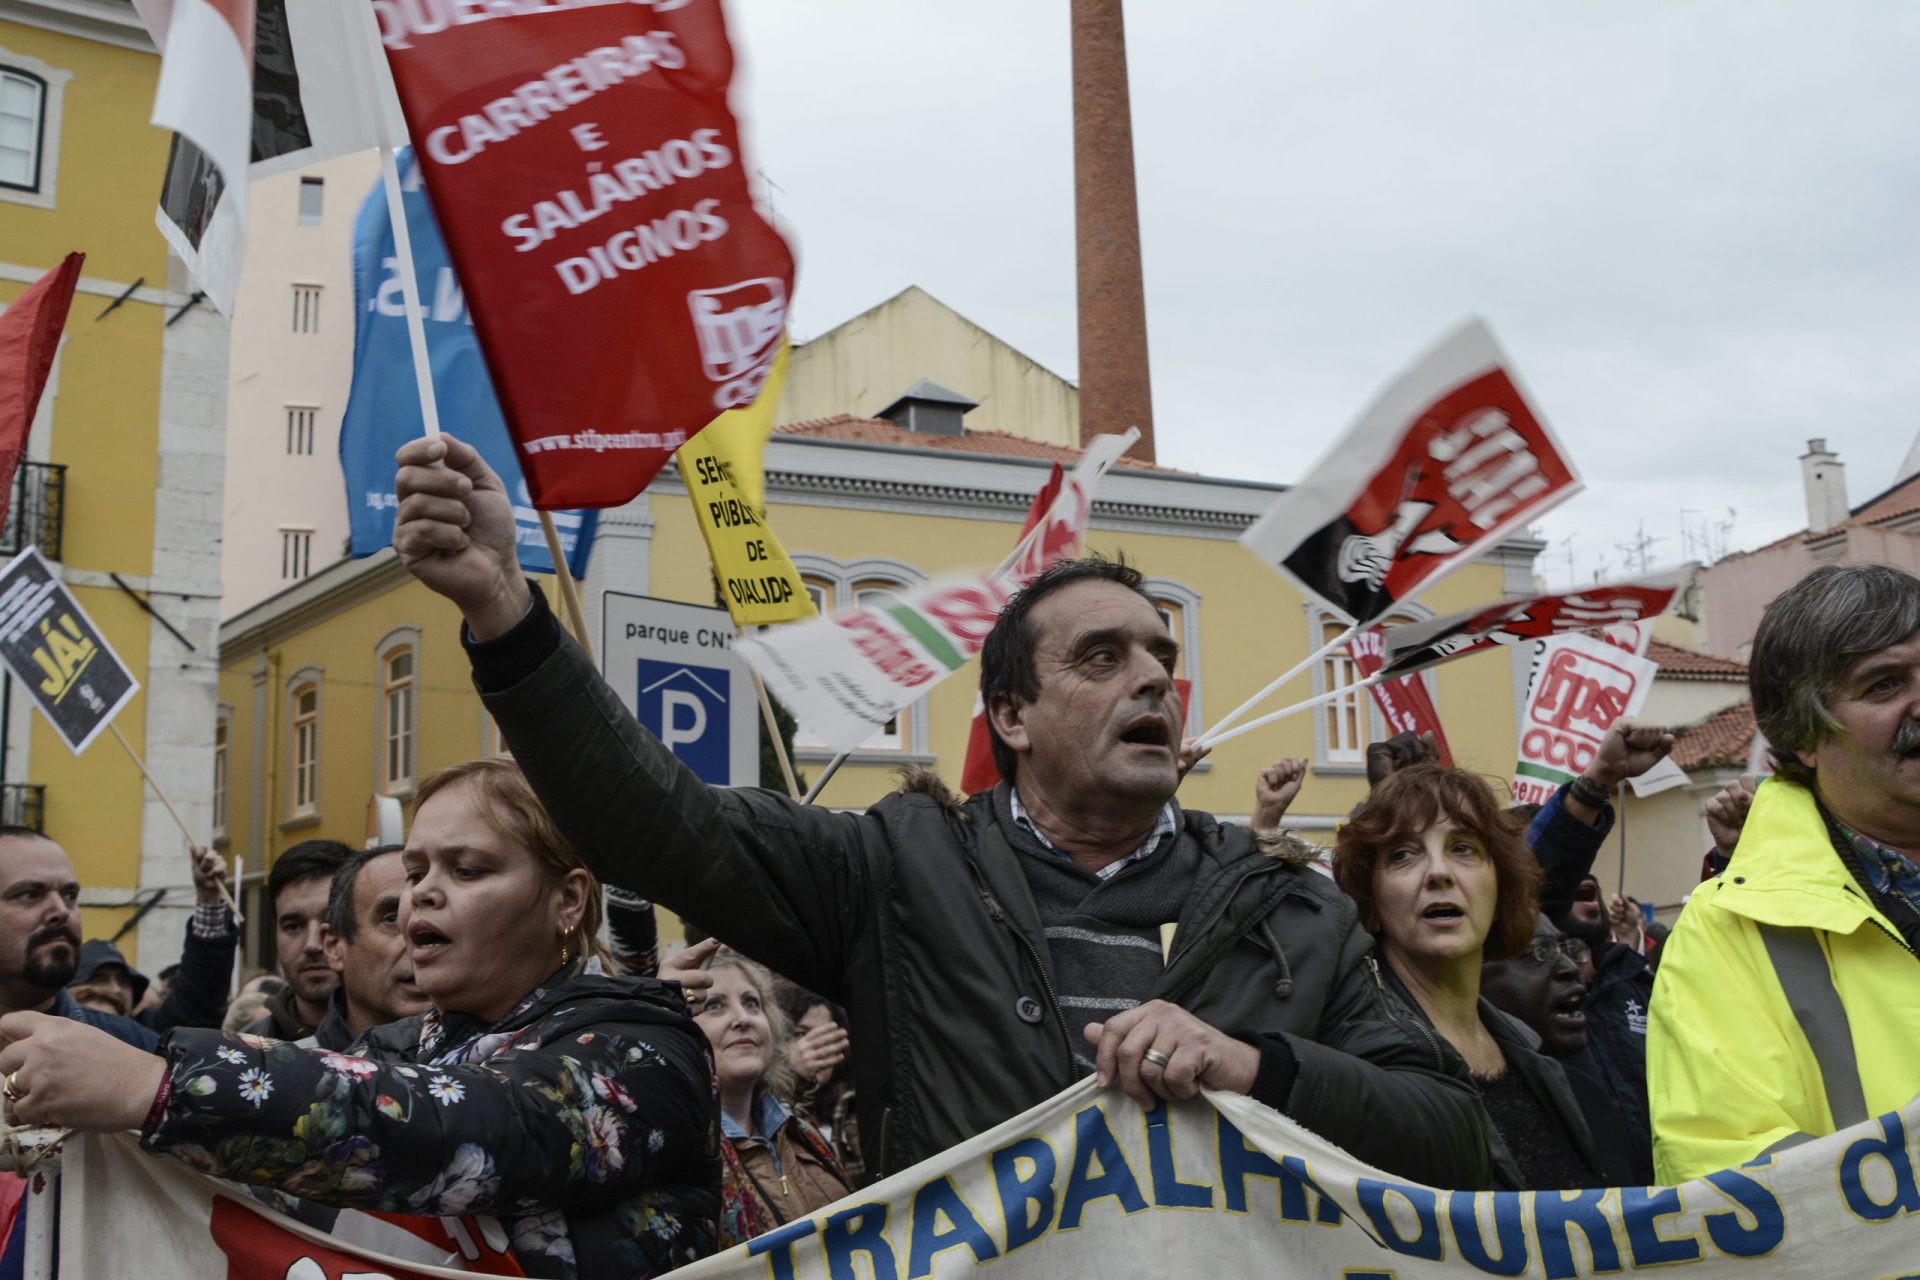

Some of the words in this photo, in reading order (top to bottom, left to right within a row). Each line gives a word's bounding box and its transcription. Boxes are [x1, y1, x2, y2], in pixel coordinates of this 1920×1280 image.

[425, 30, 687, 165] CARREIRAS
[570, 122, 610, 151] E
[501, 128, 732, 252] SALÁRIOS
[554, 198, 729, 295] DIGNOS
[746, 540, 768, 562] DE
[32, 613, 95, 697] JÁ!
[626, 623, 689, 644] parque
[662, 689, 707, 752] P
[745, 1098, 1787, 1280] TRABALHDORES
[1839, 1110, 1920, 1222] d
